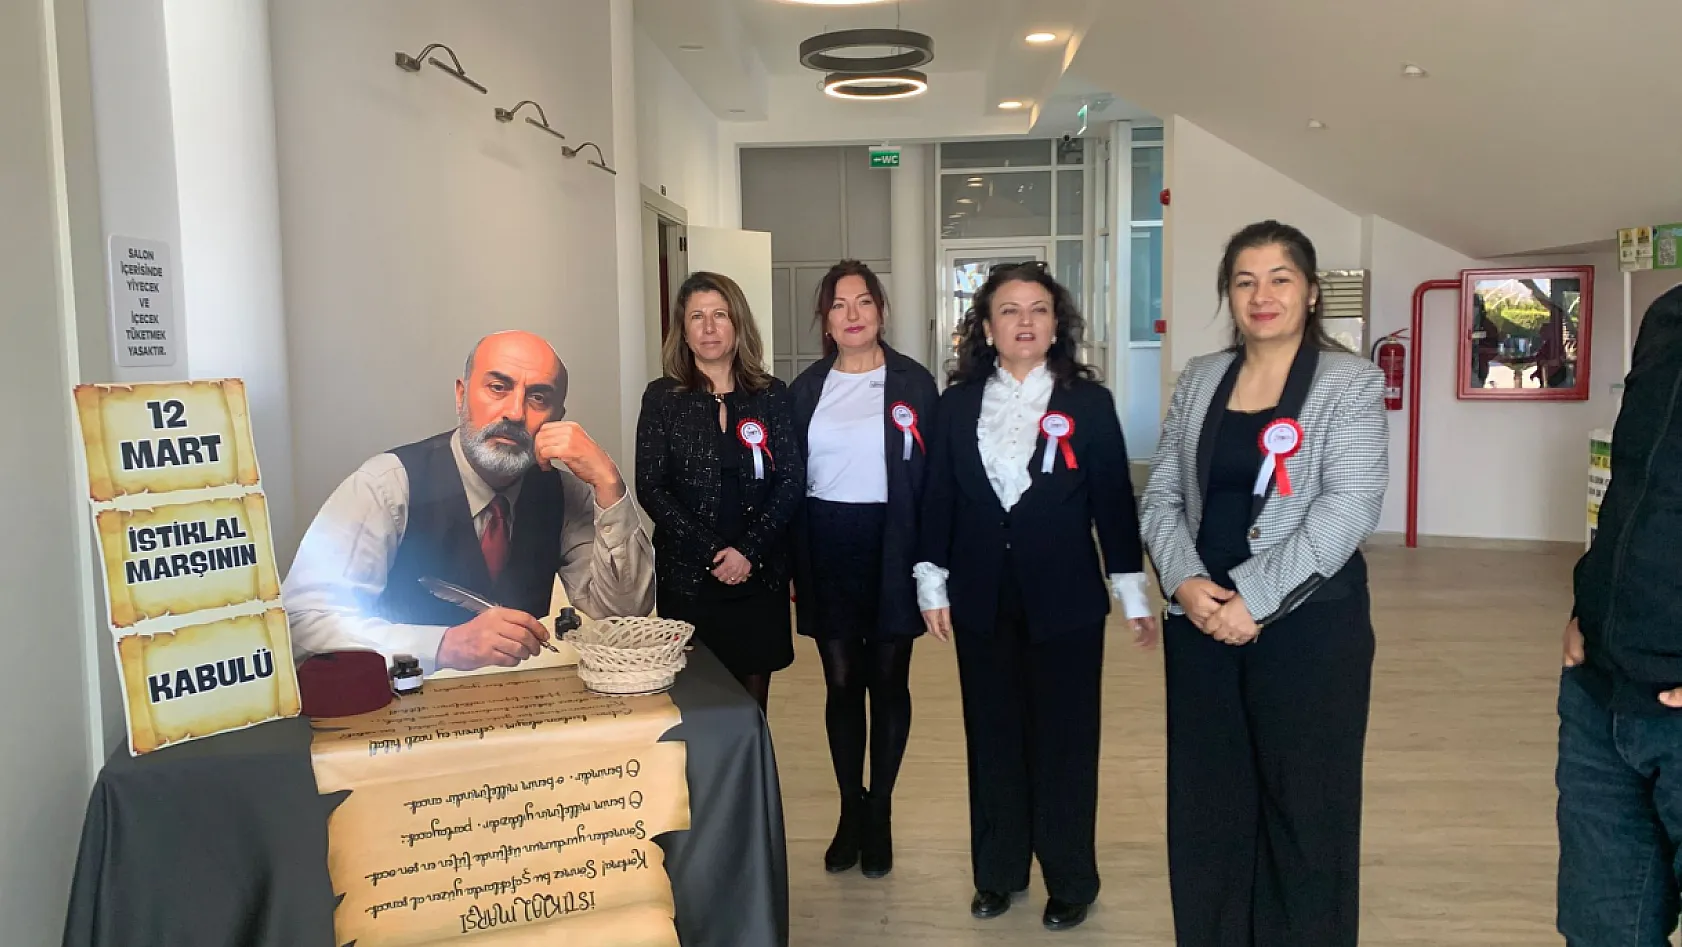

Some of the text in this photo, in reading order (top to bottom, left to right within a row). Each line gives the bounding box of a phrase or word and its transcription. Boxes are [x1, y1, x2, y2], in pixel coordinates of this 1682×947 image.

[881, 155, 899, 164] WC
[128, 248, 155, 260] SALON
[120, 260, 163, 277] İÇERİSİNDE
[126, 278, 160, 293] YİYECEK
[138, 297, 150, 308] VE
[131, 310, 160, 325] İÇECEK
[125, 326, 167, 341] TÜKETMEK
[127, 346, 167, 356] YASAKTIR.
[146, 399, 189, 431] 12
[120, 434, 222, 471] MART
[128, 517, 247, 553] İSTİKLAL
[124, 543, 258, 585] MARŞININ
[147, 649, 275, 704] KABULÜ
[437, 730, 450, 740] ey
[626, 759, 640, 777] O
[521, 777, 554, 790] benim
[556, 776, 564, 784] o
[446, 784, 518, 808] milletimindir
[593, 797, 624, 809] benim
[629, 791, 642, 809] O
[404, 798, 442, 814] ancak
[535, 803, 590, 821] milletimin
[522, 824, 586, 853] yurdumun
[587, 820, 646, 845] Sönmeden
[438, 852, 471, 872] tüten
[473, 845, 522, 866] üstünde
[602, 849, 648, 876] Korkma!
[421, 863, 436, 873] en
[553, 860, 597, 879] Sönmez
[365, 870, 395, 886] ocak
[465, 868, 531, 899] şafaklarda
[534, 872, 550, 885] bu
[426, 878, 463, 901] yüzen
[410, 897, 425, 910] al
[460, 903, 516, 933] MARŞI
